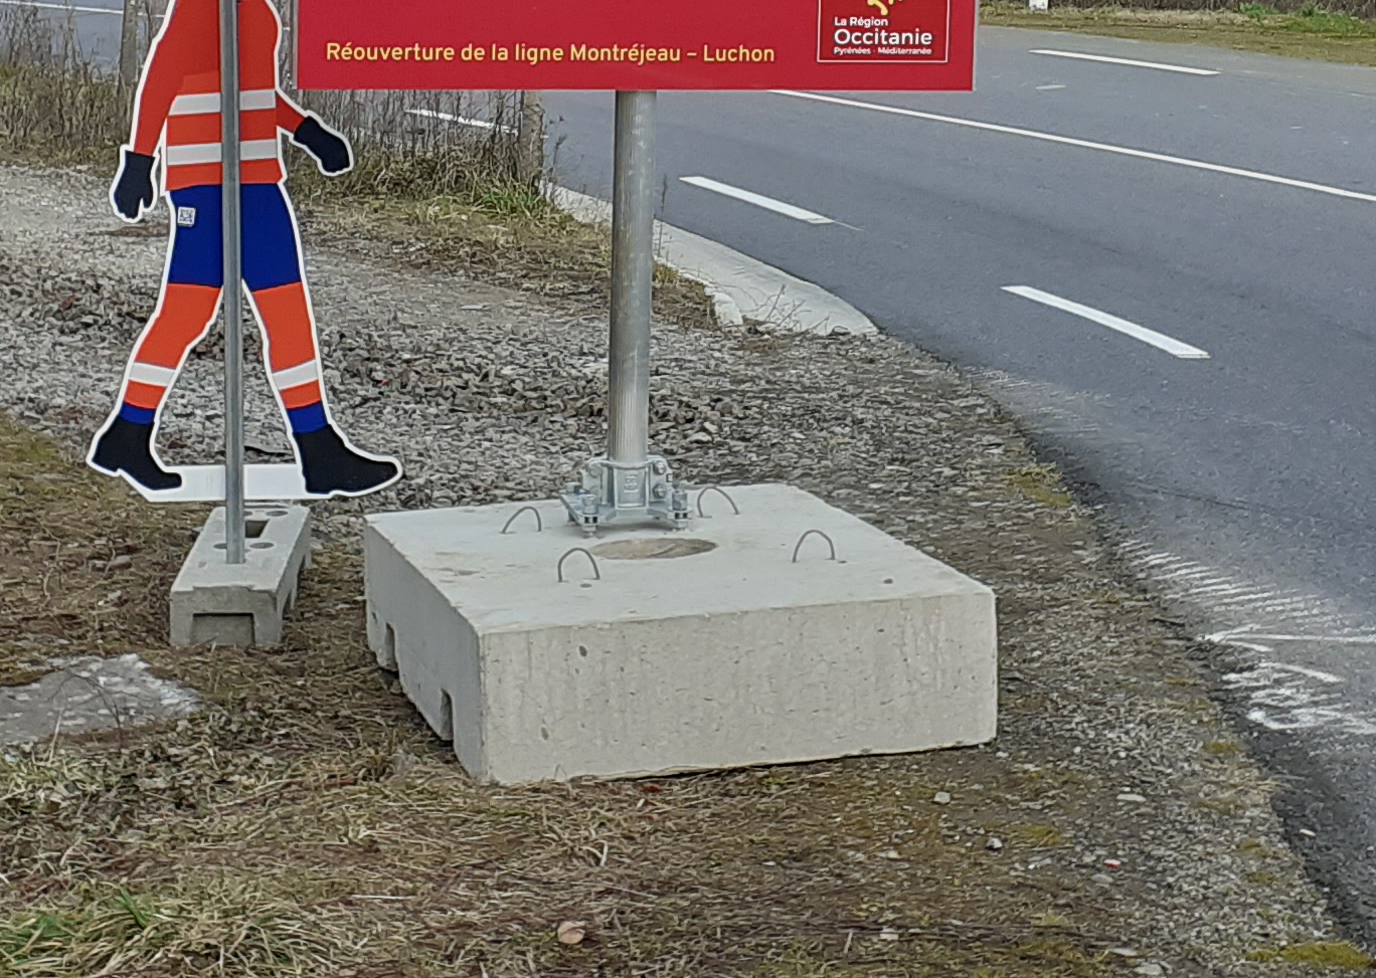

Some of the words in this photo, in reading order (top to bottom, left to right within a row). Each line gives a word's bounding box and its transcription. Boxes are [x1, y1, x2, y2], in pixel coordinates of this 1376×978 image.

[834, 16, 847, 26] La
[849, 16, 889, 28] Région
[834, 27, 933, 46] Occitanie
[326, 41, 455, 61] Réouverture
[460, 43, 485, 61] de
[491, 43, 509, 61] la
[515, 43, 564, 66] ligne
[570, 43, 681, 66] Montréjeau
[703, 44, 775, 62] Luchon
